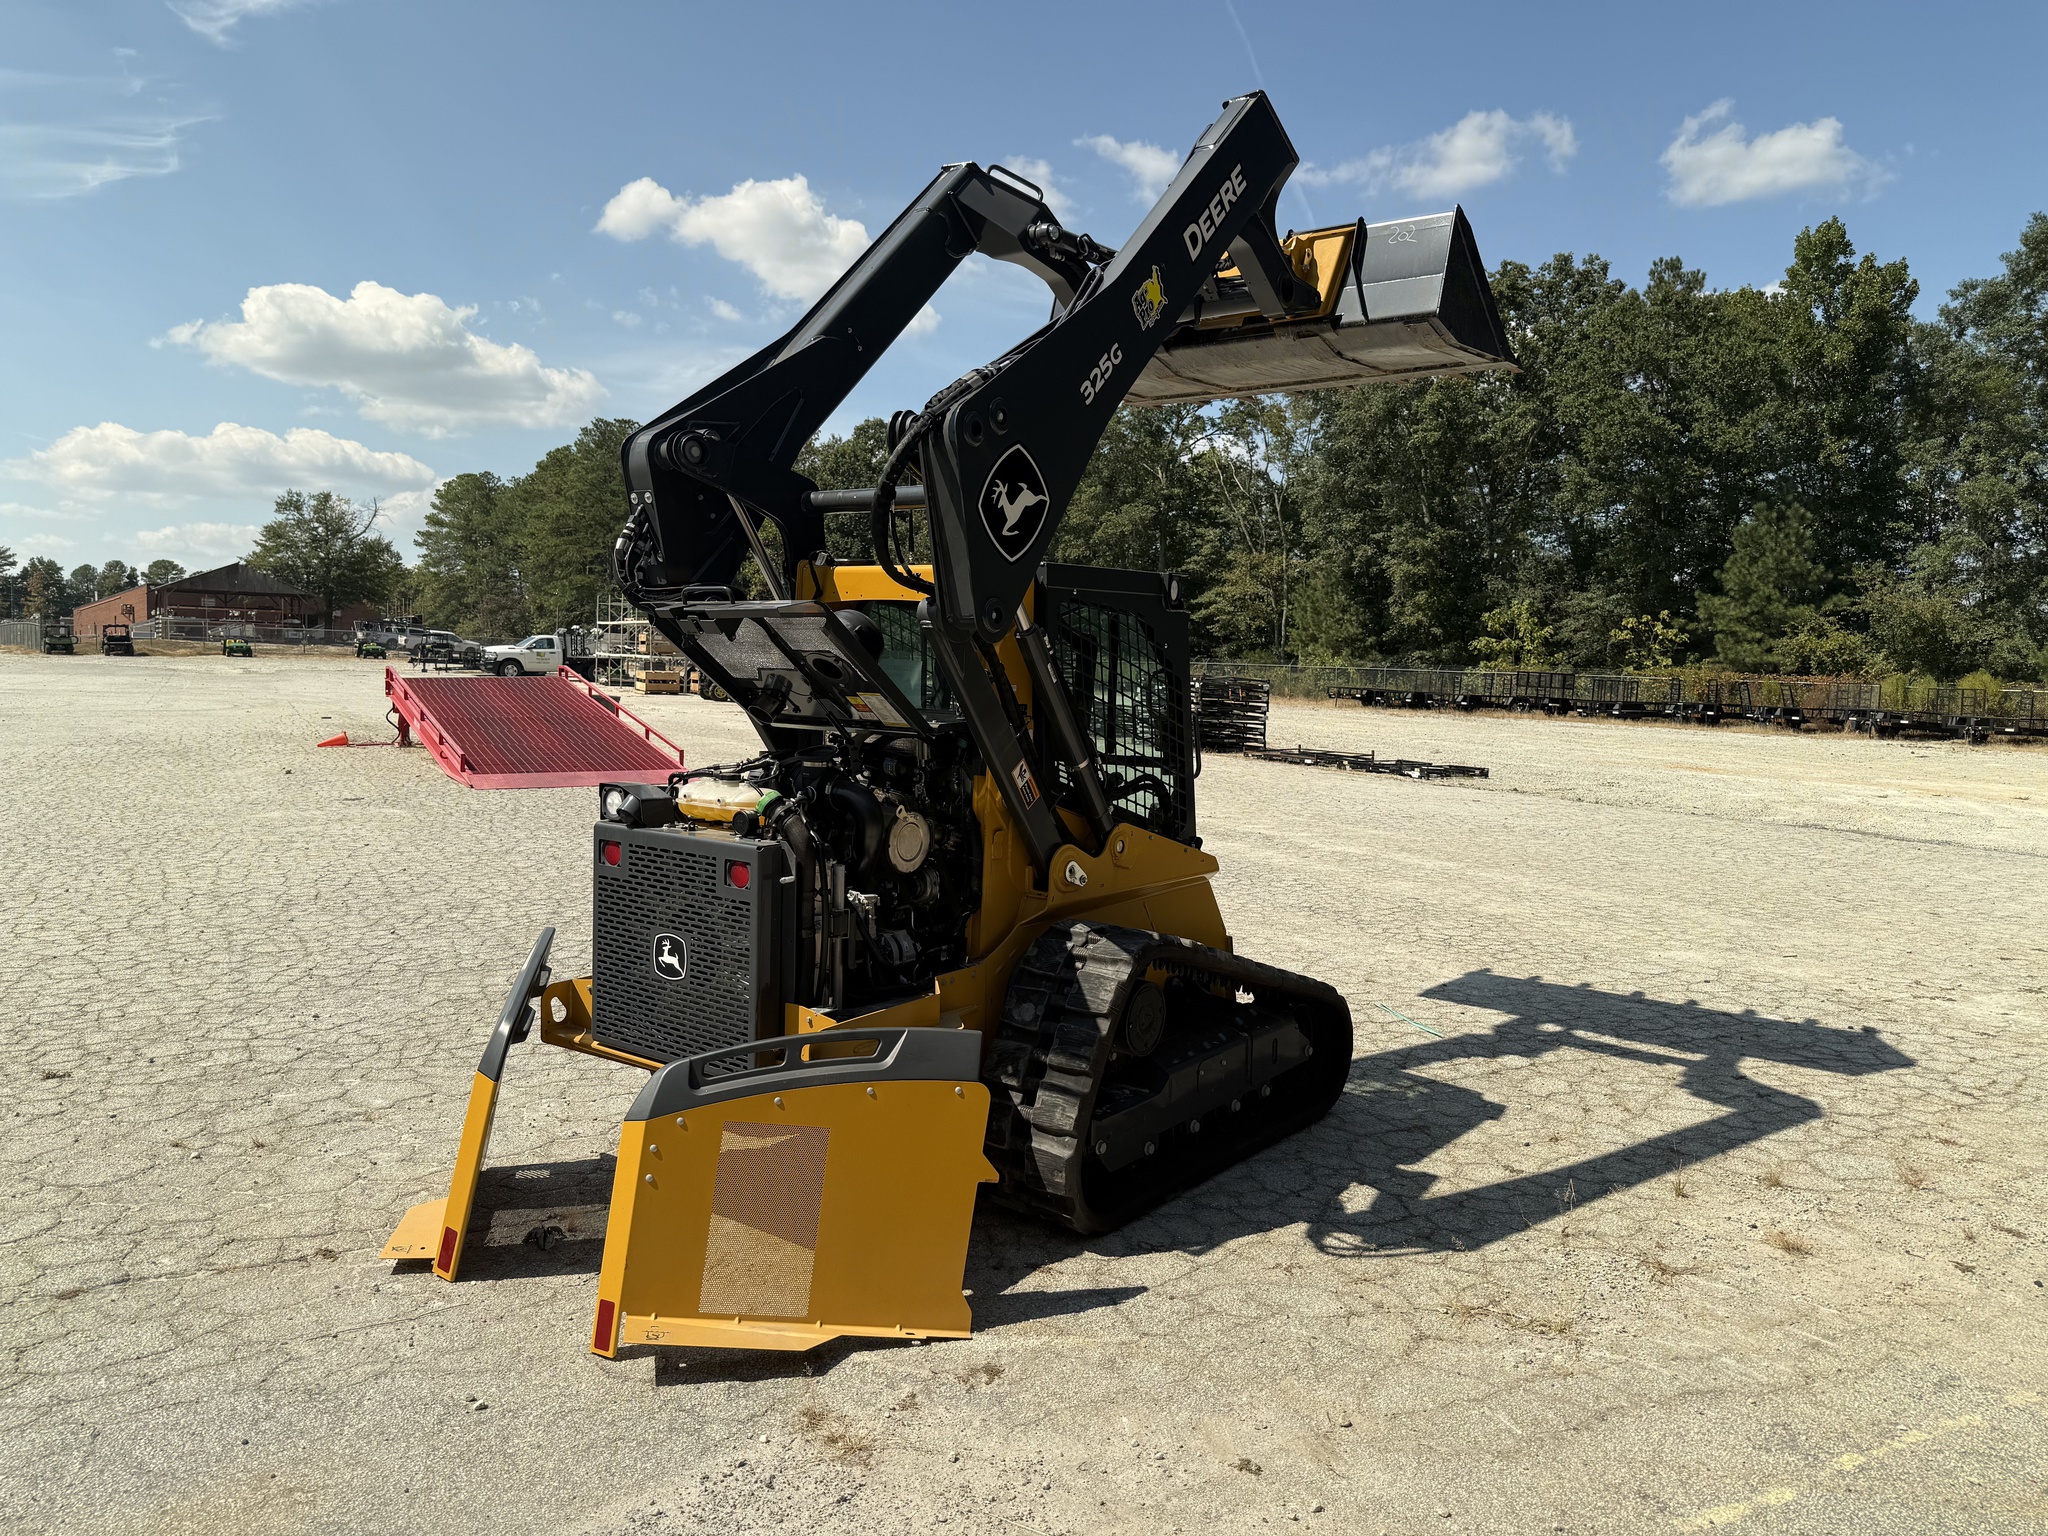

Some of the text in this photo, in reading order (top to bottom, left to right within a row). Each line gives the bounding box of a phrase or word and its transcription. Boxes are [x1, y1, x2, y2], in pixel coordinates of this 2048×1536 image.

[1183, 163, 1247, 262] DEERE
[1388, 224, 1418, 244] 202
[1080, 343, 1123, 405] 325G
